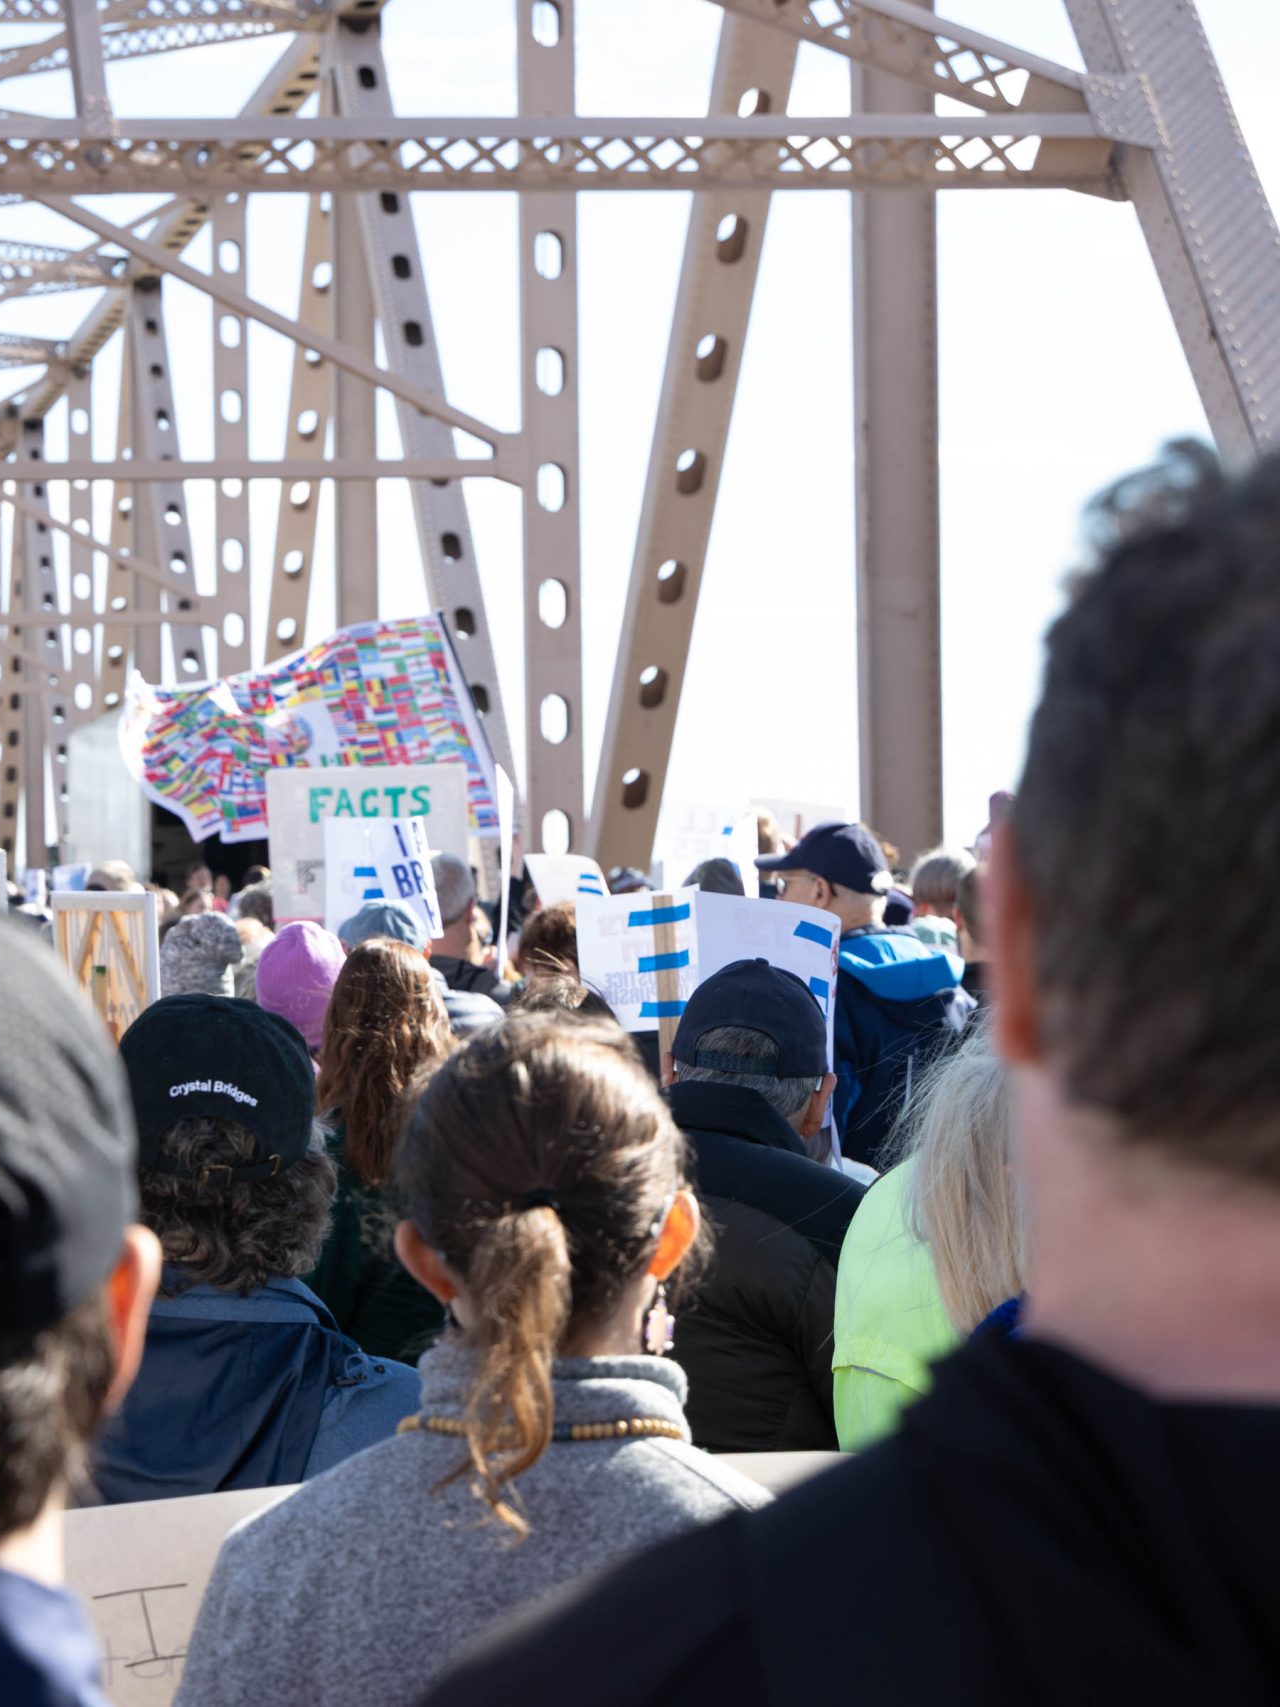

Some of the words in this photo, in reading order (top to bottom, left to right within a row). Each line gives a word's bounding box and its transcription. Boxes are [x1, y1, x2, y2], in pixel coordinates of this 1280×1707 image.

[309, 785, 431, 824] FACTS
[169, 1079, 212, 1098] Crystal
[213, 1080, 258, 1107] Bridges
